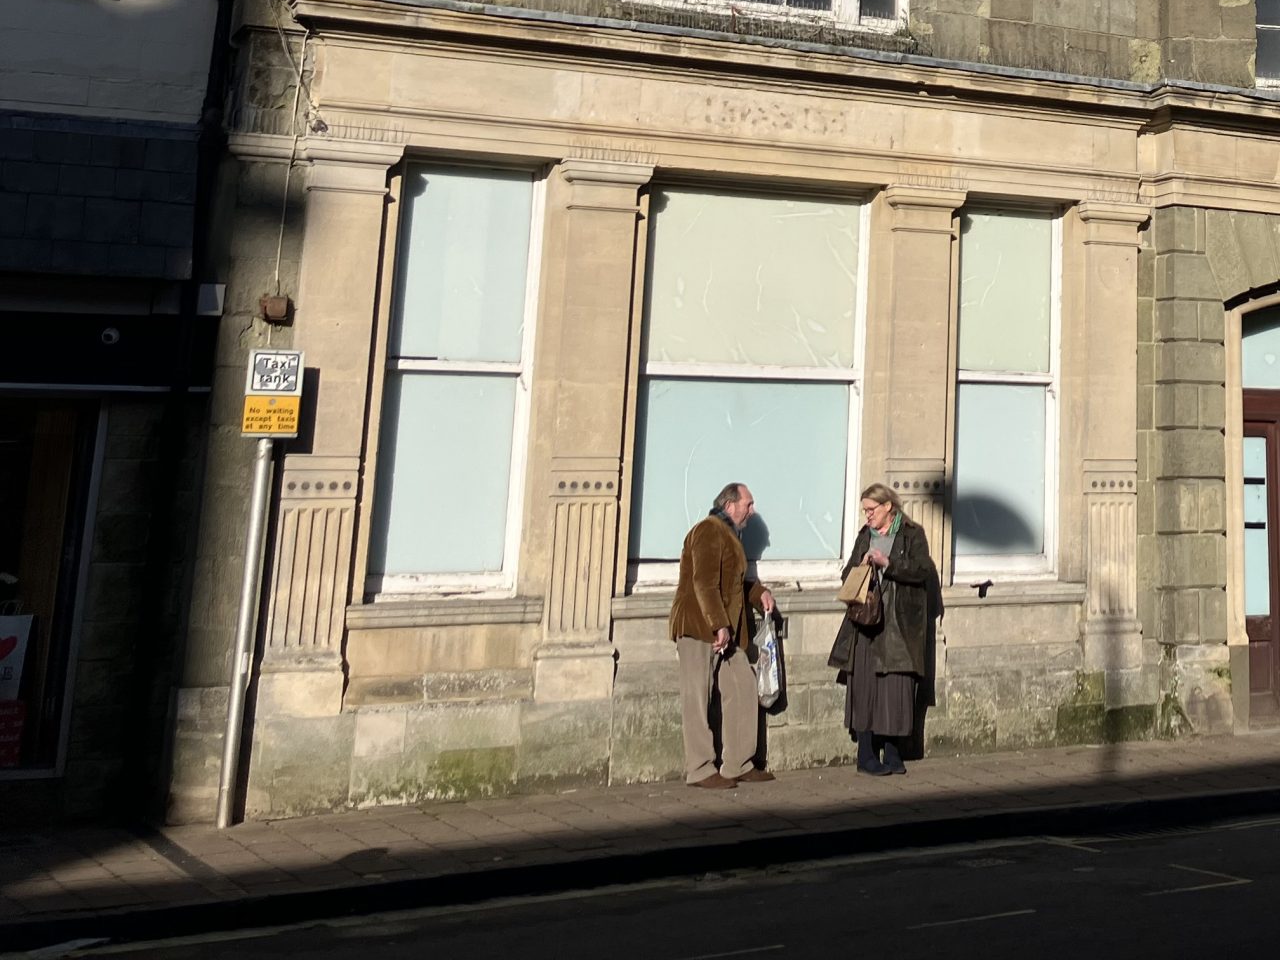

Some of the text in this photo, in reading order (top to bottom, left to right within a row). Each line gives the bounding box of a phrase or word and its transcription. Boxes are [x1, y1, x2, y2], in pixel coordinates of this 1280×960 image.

[263, 357, 292, 370] Taxi
[259, 373, 290, 384] rank
[266, 407, 294, 415] waiting
[245, 415, 296, 423] except taxis
